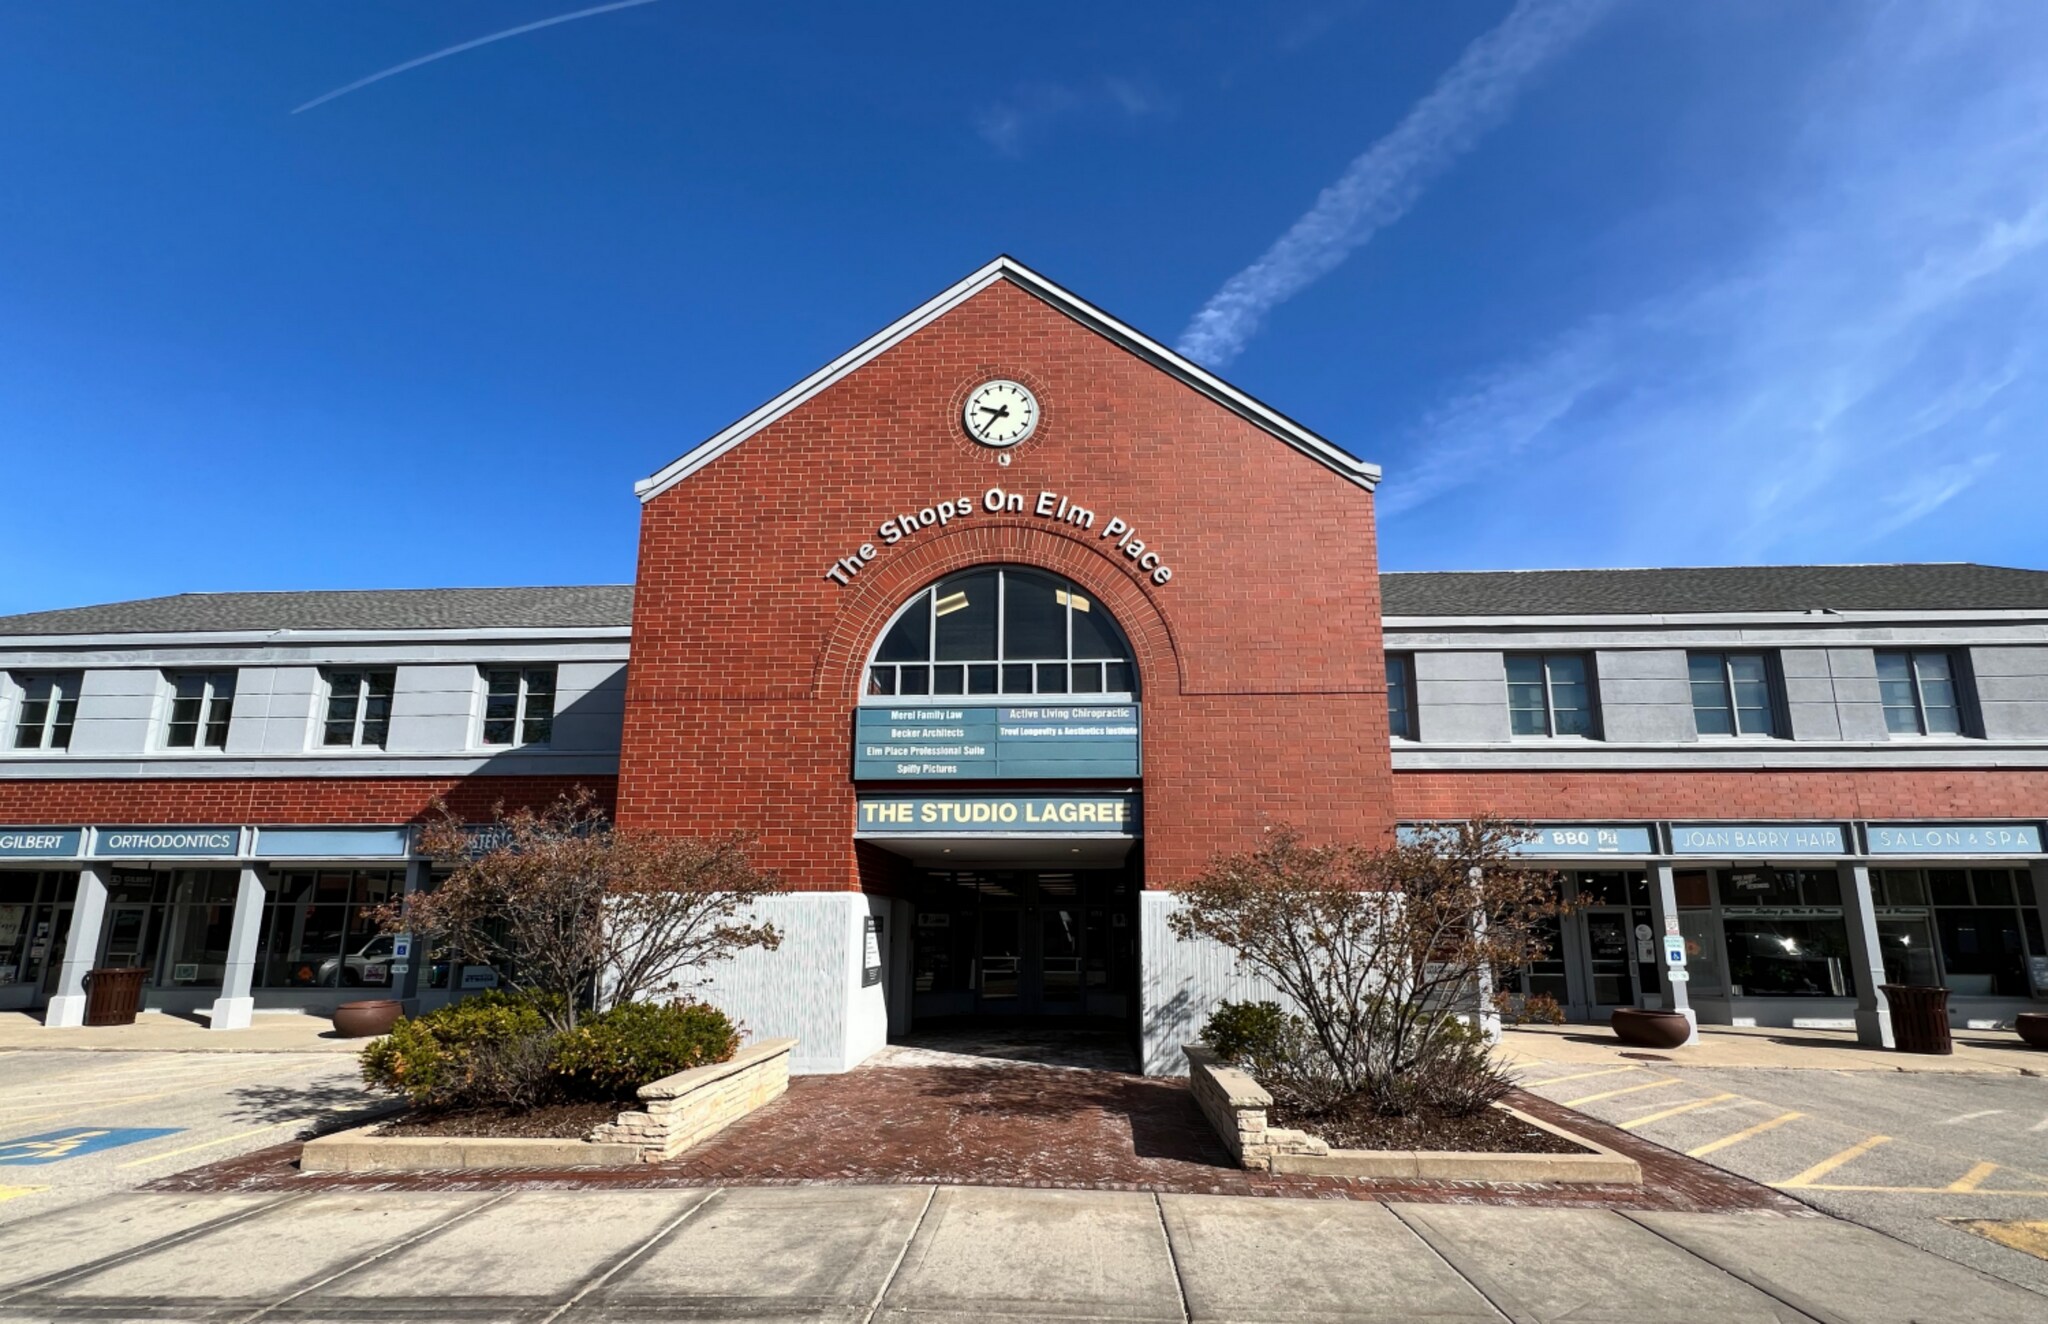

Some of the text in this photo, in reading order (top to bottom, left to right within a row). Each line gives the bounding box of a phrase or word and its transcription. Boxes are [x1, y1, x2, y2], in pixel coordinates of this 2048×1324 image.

[825, 487, 1174, 586] The Shops On Elm Place
[917, 710, 945, 720] Family
[946, 710, 963, 720] Law
[1010, 708, 1130, 719] Active Living Chiropractic
[891, 728, 965, 738] Becker Architects
[866, 746, 985, 756] Elm Place Professional Suite
[897, 764, 957, 774] Spiffy Pictures
[862, 803, 1131, 823] THE STUDIO LAGREE
[0, 834, 230, 849] GILBERT ORTHODONTICS
[1552, 831, 1589, 846] BBQ
[1597, 831, 1618, 845] Pit
[1683, 831, 1836, 847] JOAN BARRY HAIR
[1880, 831, 2029, 847] SALON & SPA
